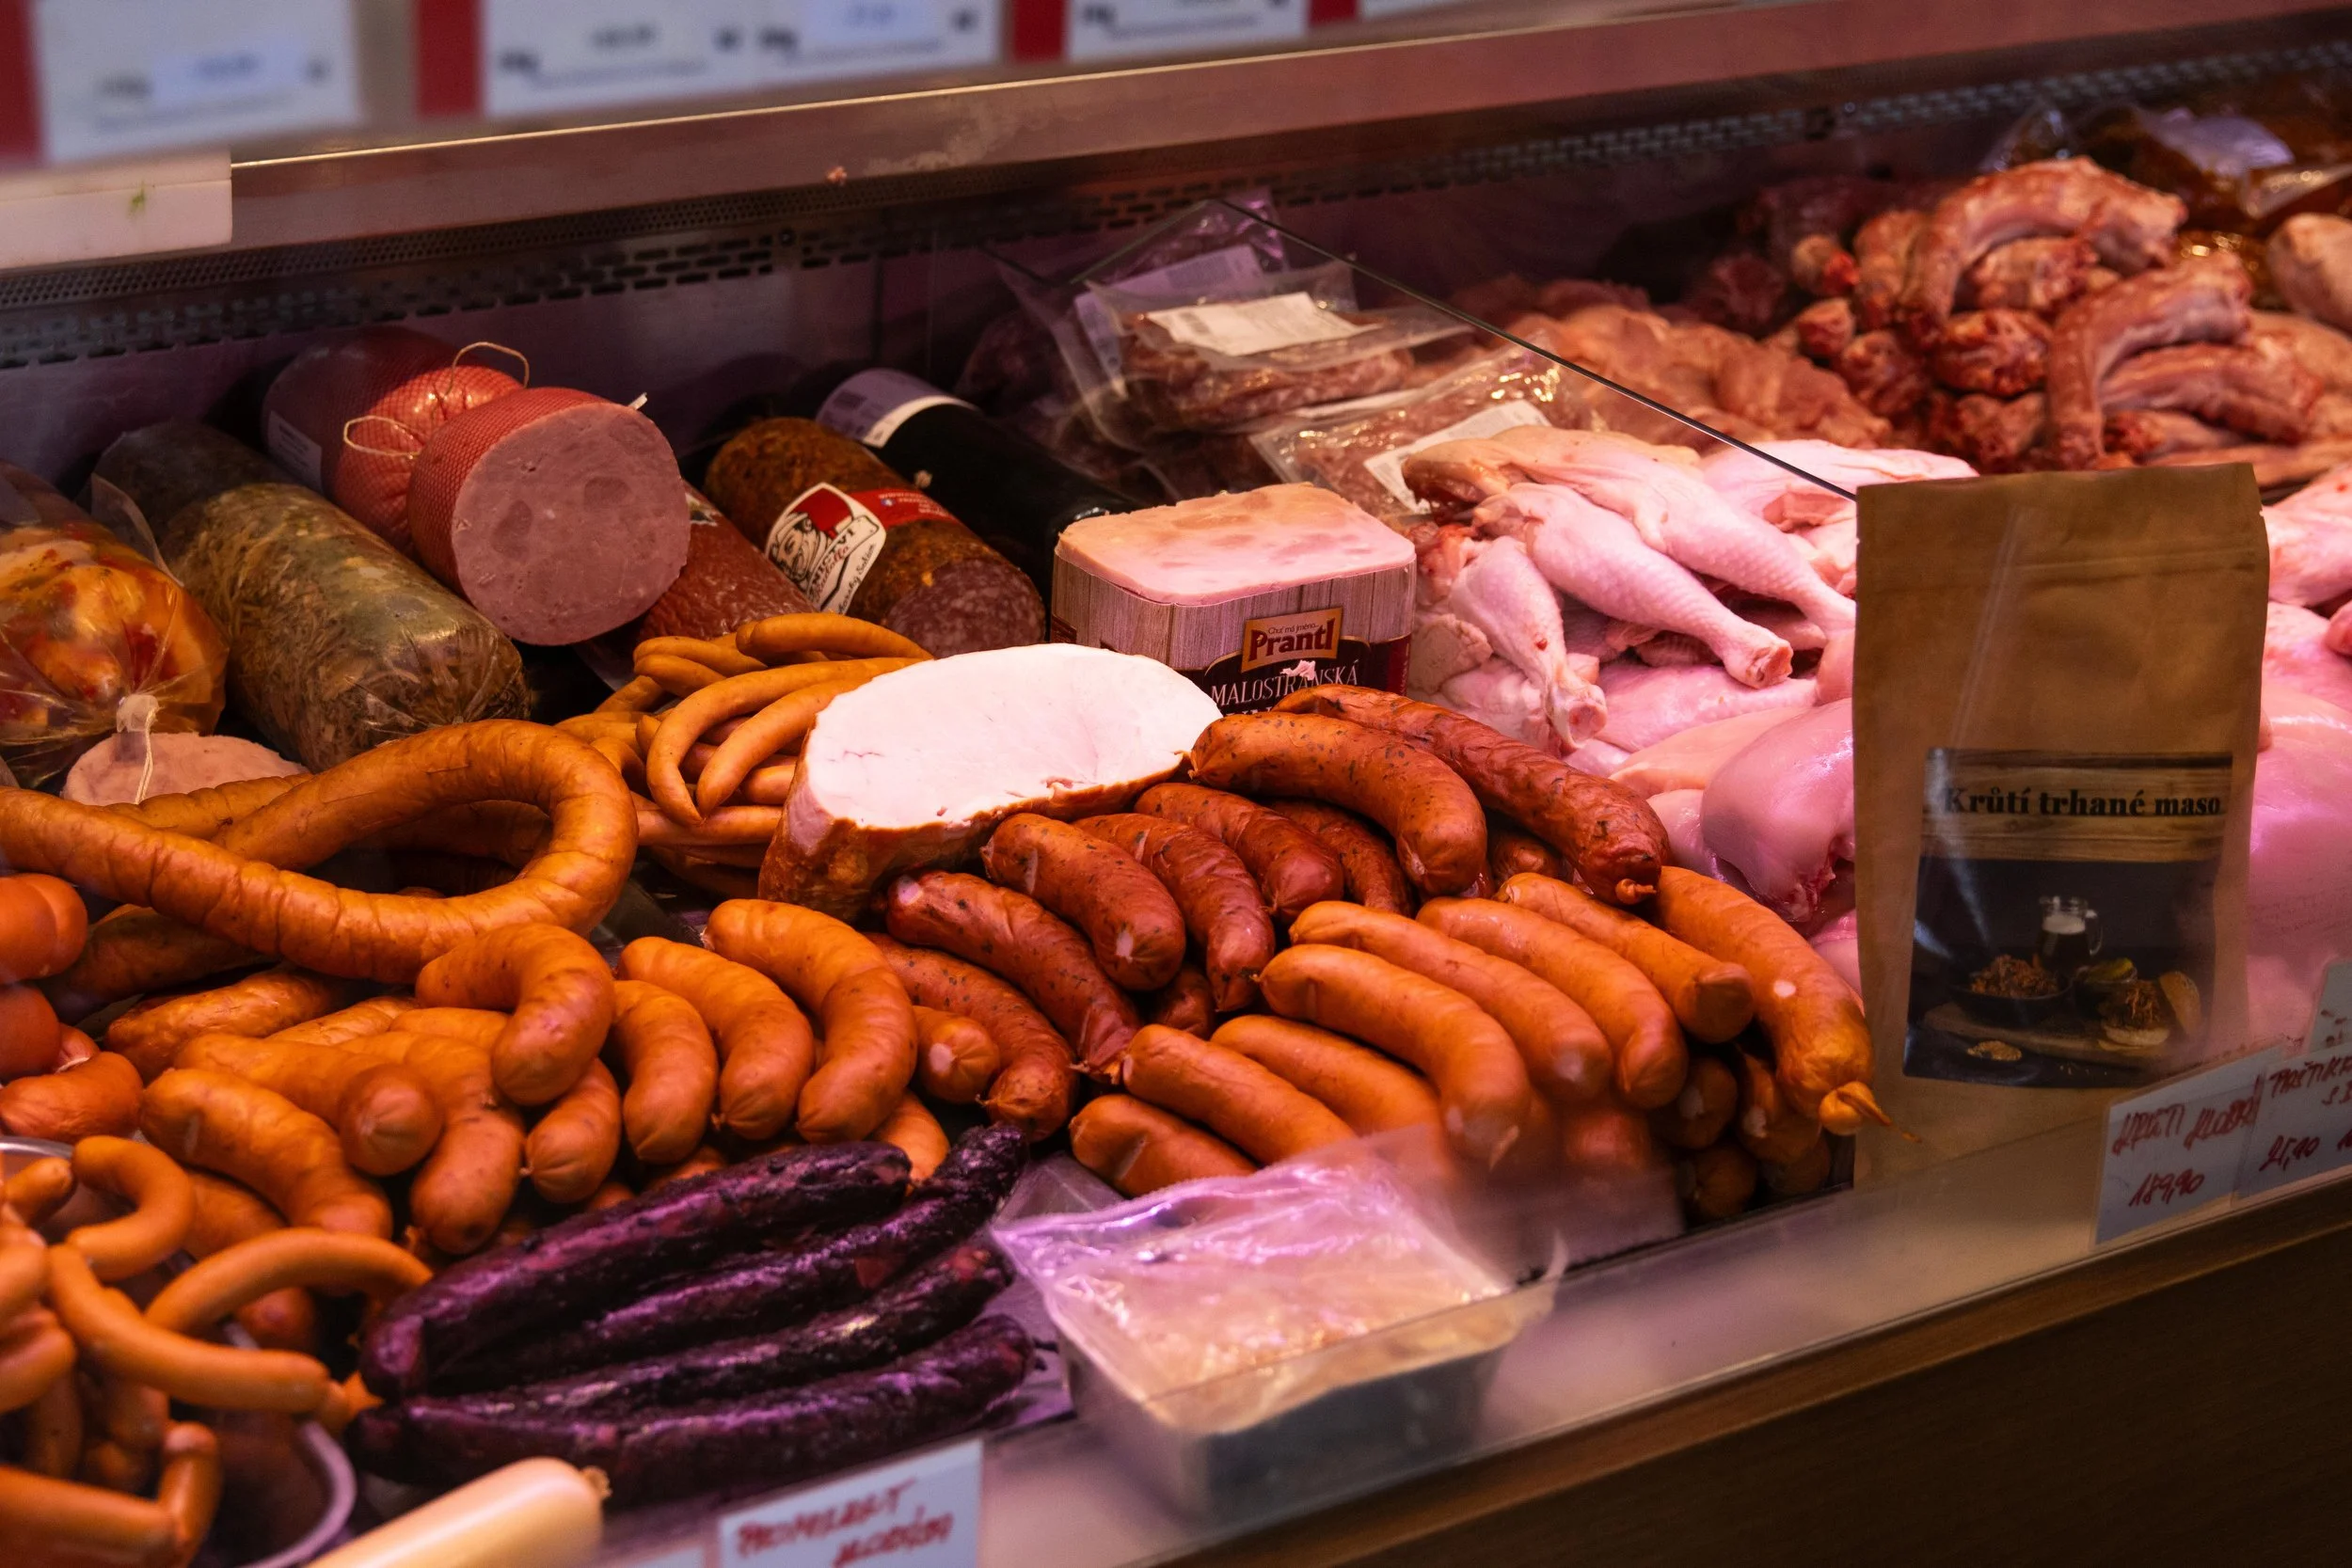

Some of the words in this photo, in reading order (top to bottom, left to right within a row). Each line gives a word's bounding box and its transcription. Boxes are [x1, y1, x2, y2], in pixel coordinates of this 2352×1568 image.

[1248, 616, 1336, 662] Prantl
[1944, 786, 2032, 816] Krůtí
[2039, 788, 2147, 817] trhané
[2153, 794, 2222, 817] maso
